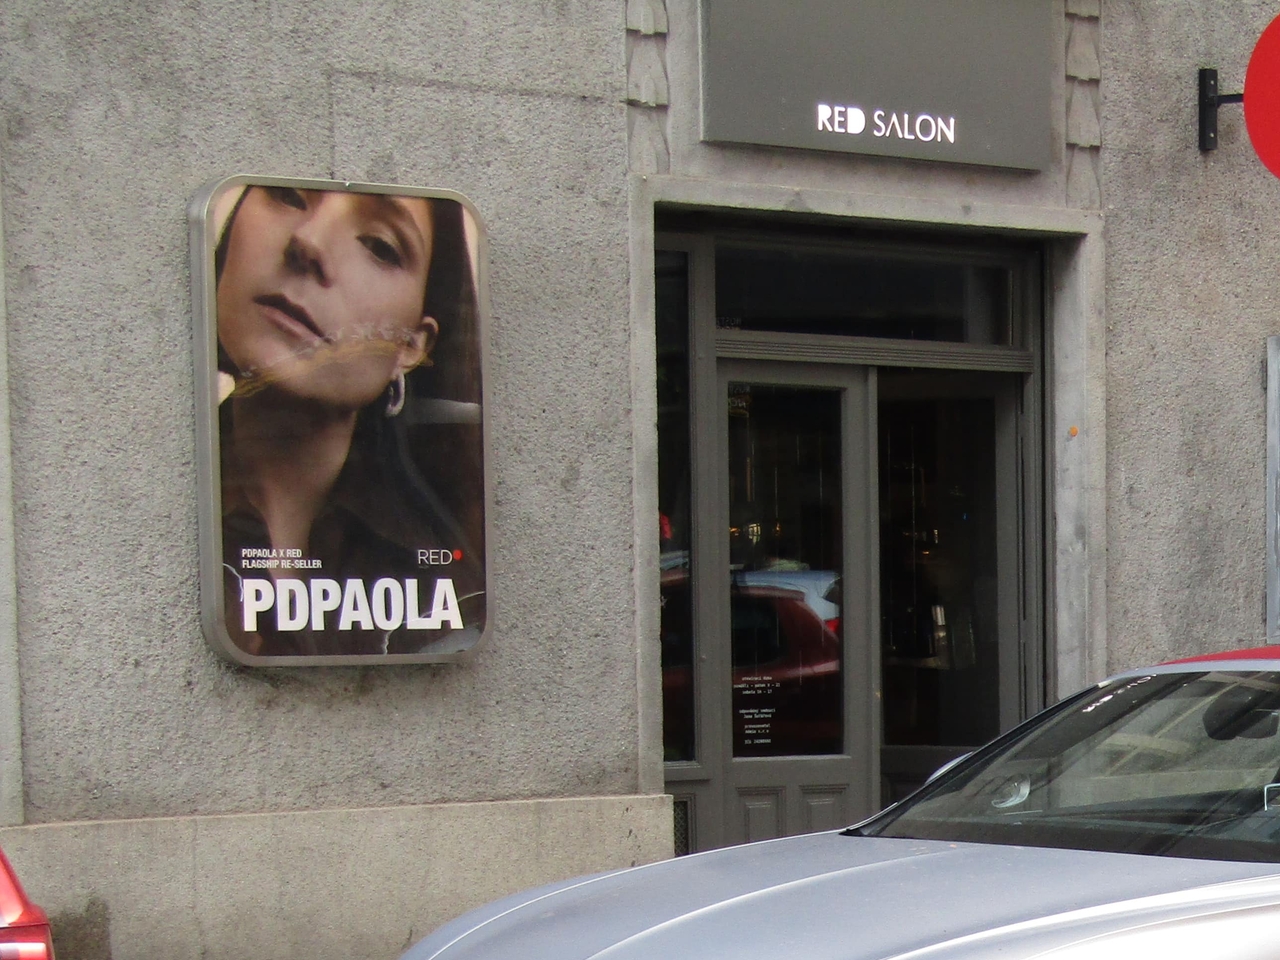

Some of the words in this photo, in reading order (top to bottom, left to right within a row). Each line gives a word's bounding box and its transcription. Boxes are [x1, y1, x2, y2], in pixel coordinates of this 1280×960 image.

[817, 104, 866, 135] RED
[873, 110, 955, 144] SALON
[242, 548, 277, 558] PDPAOLA
[279, 549, 285, 558] X
[286, 549, 302, 558] RED
[417, 549, 453, 565] RED
[242, 559, 280, 569] FLAGSHIP
[281, 559, 322, 569] RE-SELLER
[242, 577, 464, 632] PDPAOLA
